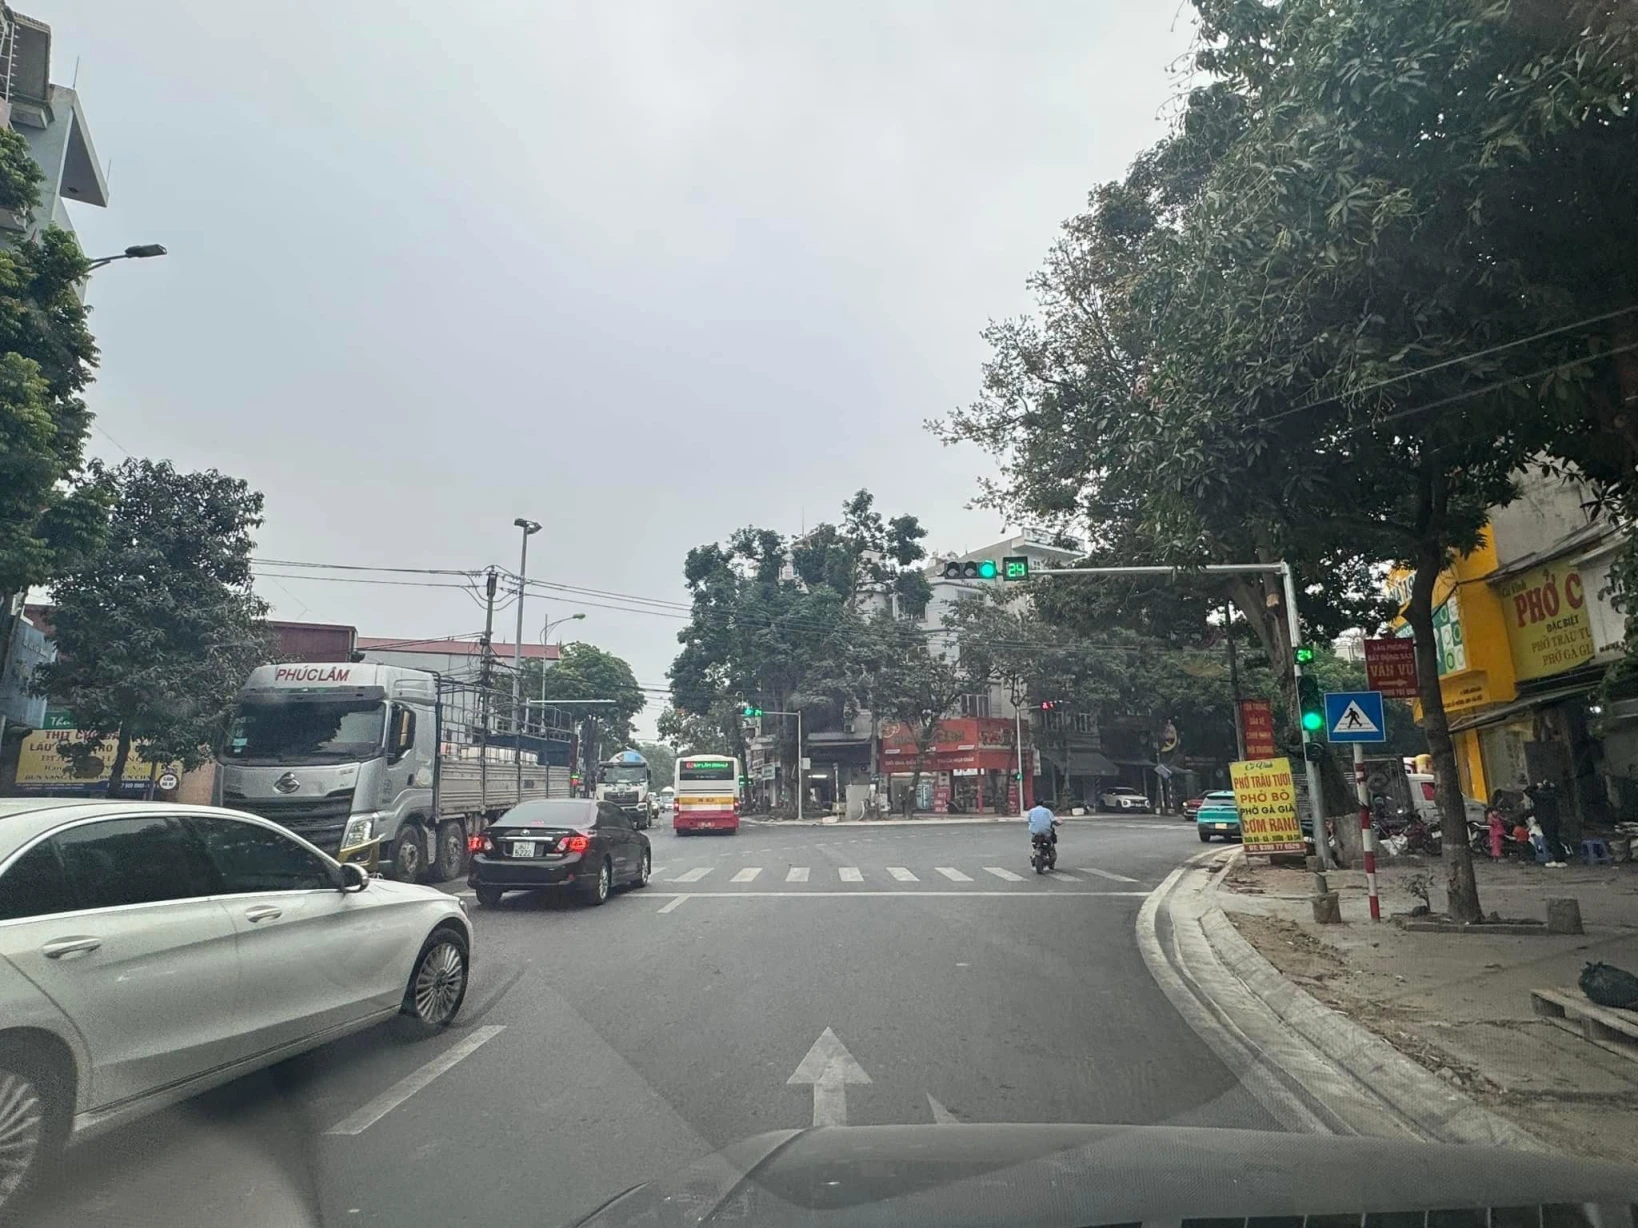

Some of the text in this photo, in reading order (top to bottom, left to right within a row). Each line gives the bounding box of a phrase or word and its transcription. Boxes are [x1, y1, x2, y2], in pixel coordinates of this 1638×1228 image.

[1008, 563, 1025, 577] 24
[1513, 569, 1560, 628] PHỞ
[1233, 773, 1250, 789] PHỞ
[1251, 773, 1271, 788] TRÂU
[1272, 789, 1290, 801] BÒ
[1240, 803, 1295, 815] PHỞ GÀ GIÀ
[1243, 817, 1267, 833] CƠM
